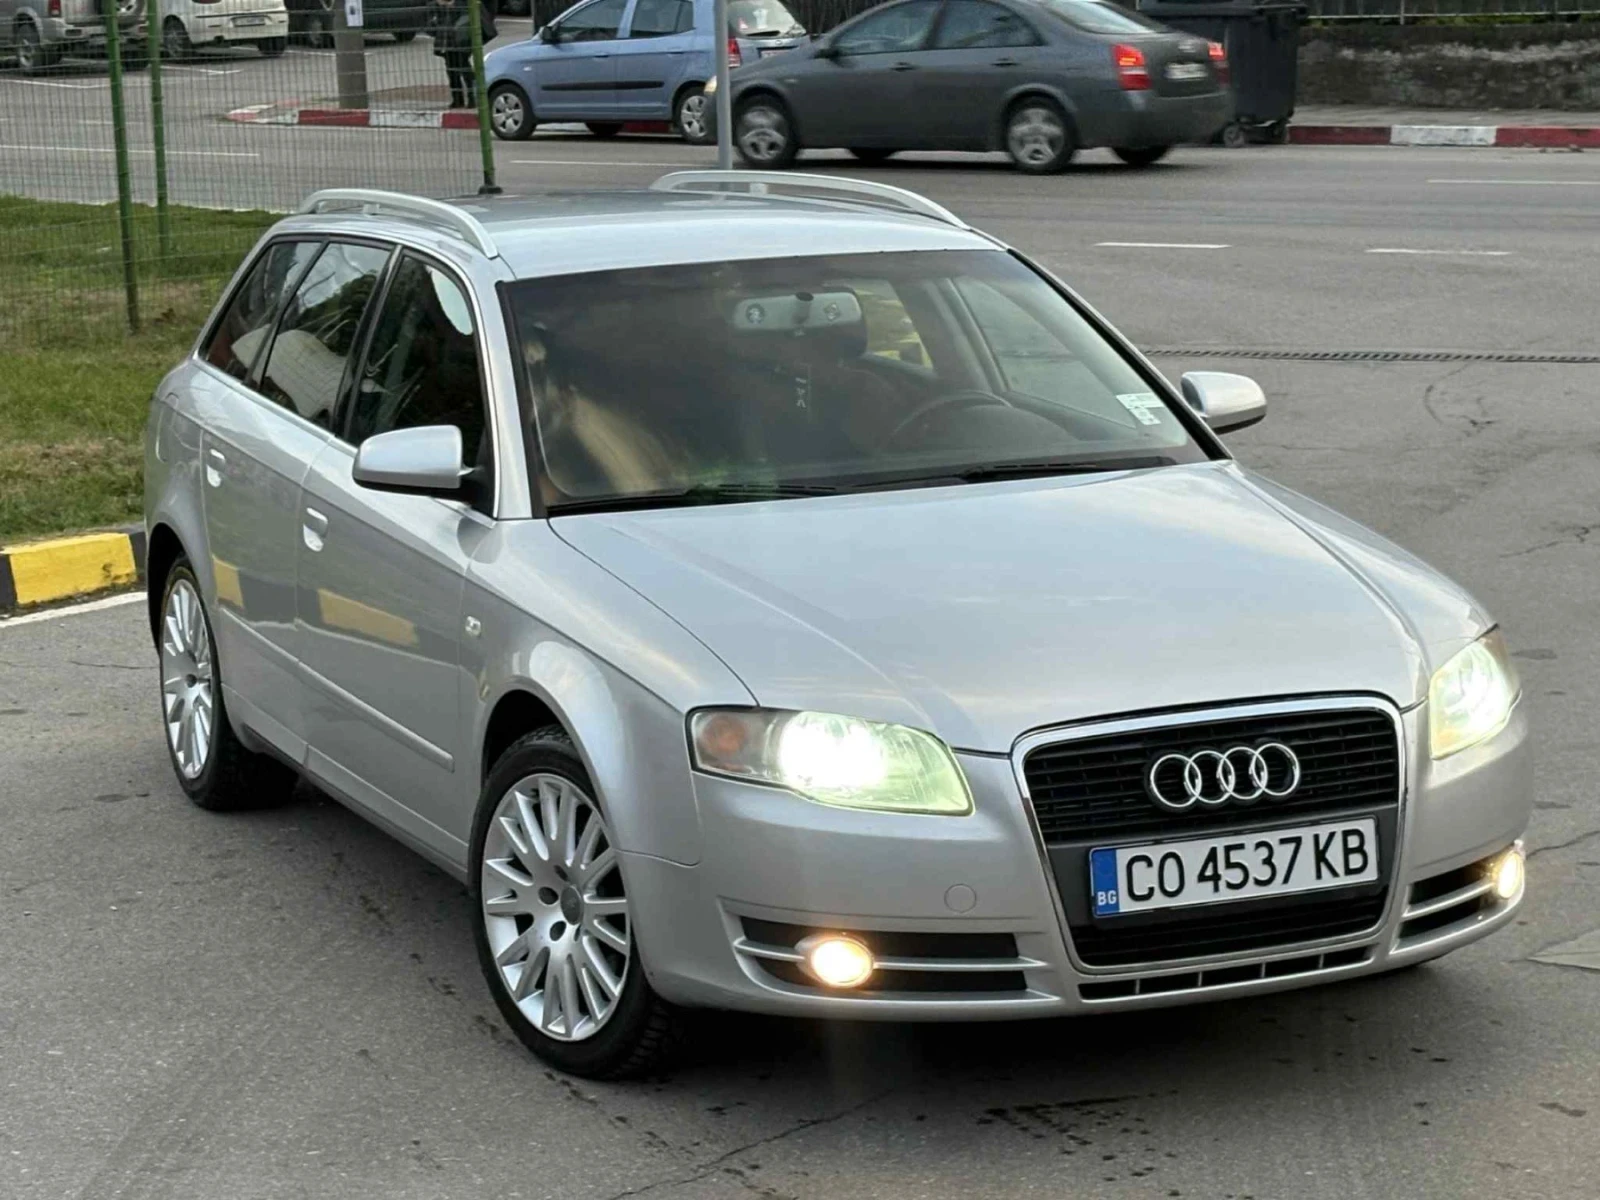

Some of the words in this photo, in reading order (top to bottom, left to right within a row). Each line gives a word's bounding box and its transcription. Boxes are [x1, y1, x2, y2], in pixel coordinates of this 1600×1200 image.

[1125, 851, 1185, 902] CO
[1197, 836, 1303, 894] 4537
[1312, 828, 1369, 881] KB
[1096, 890, 1118, 905] BG
